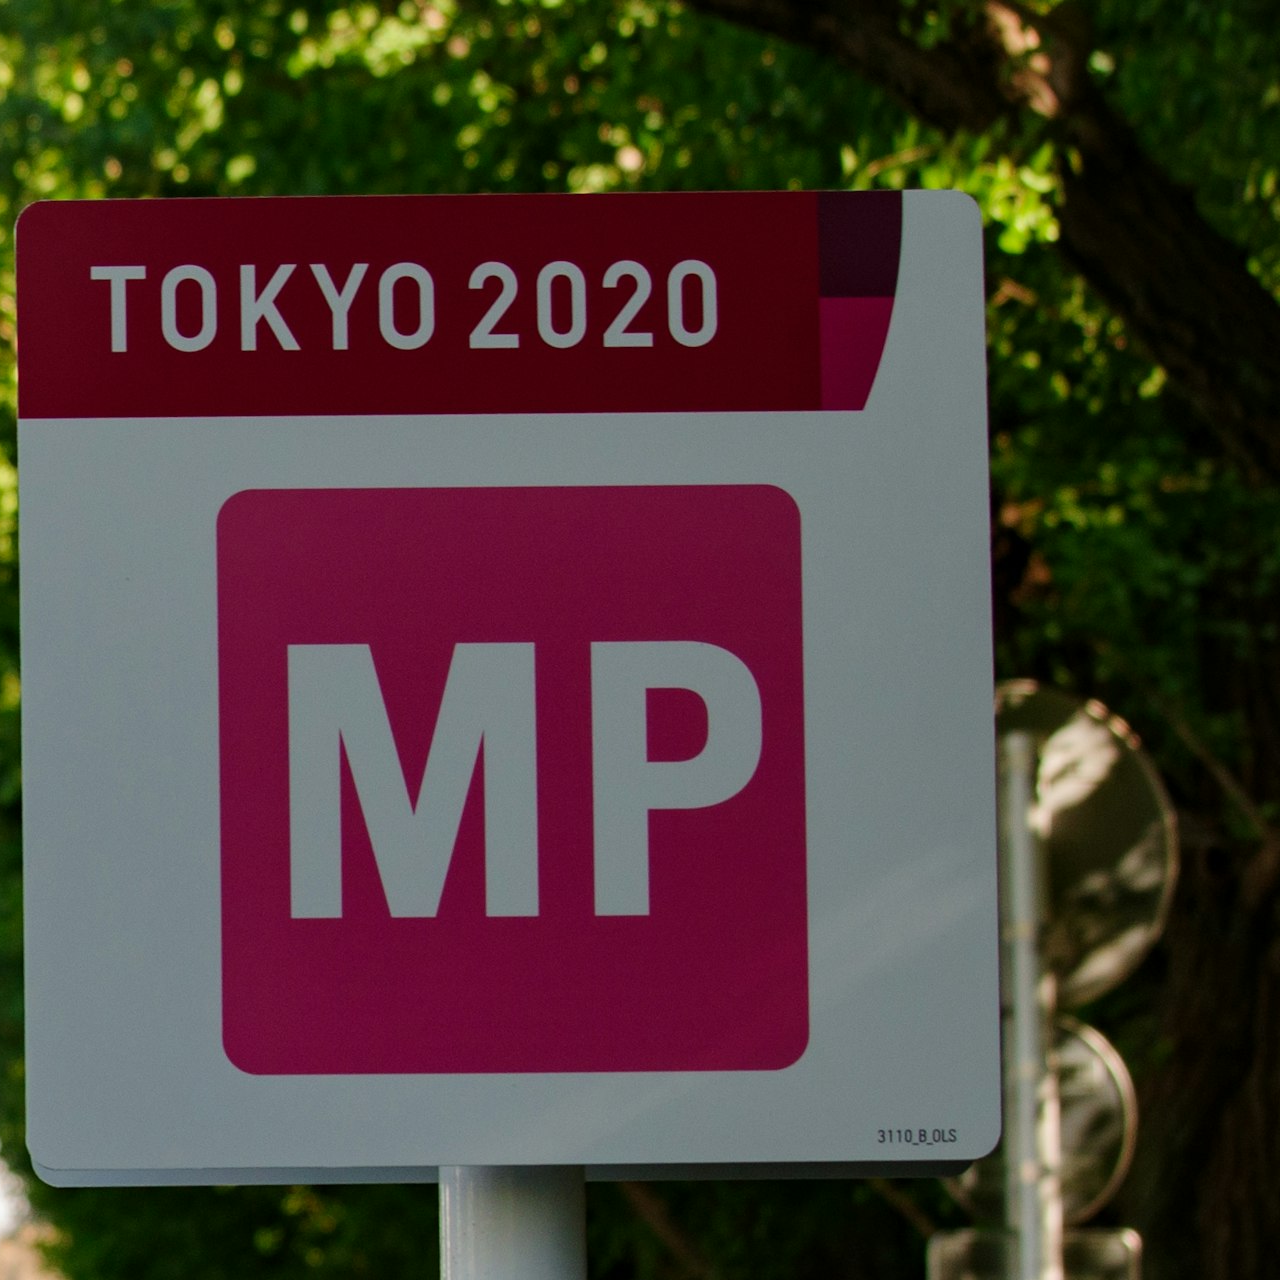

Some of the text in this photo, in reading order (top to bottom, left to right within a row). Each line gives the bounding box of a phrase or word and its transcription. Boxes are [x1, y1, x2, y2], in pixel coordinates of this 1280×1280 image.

[90, 259, 719, 353] TOKYO 2020
[286, 640, 763, 919] MP
